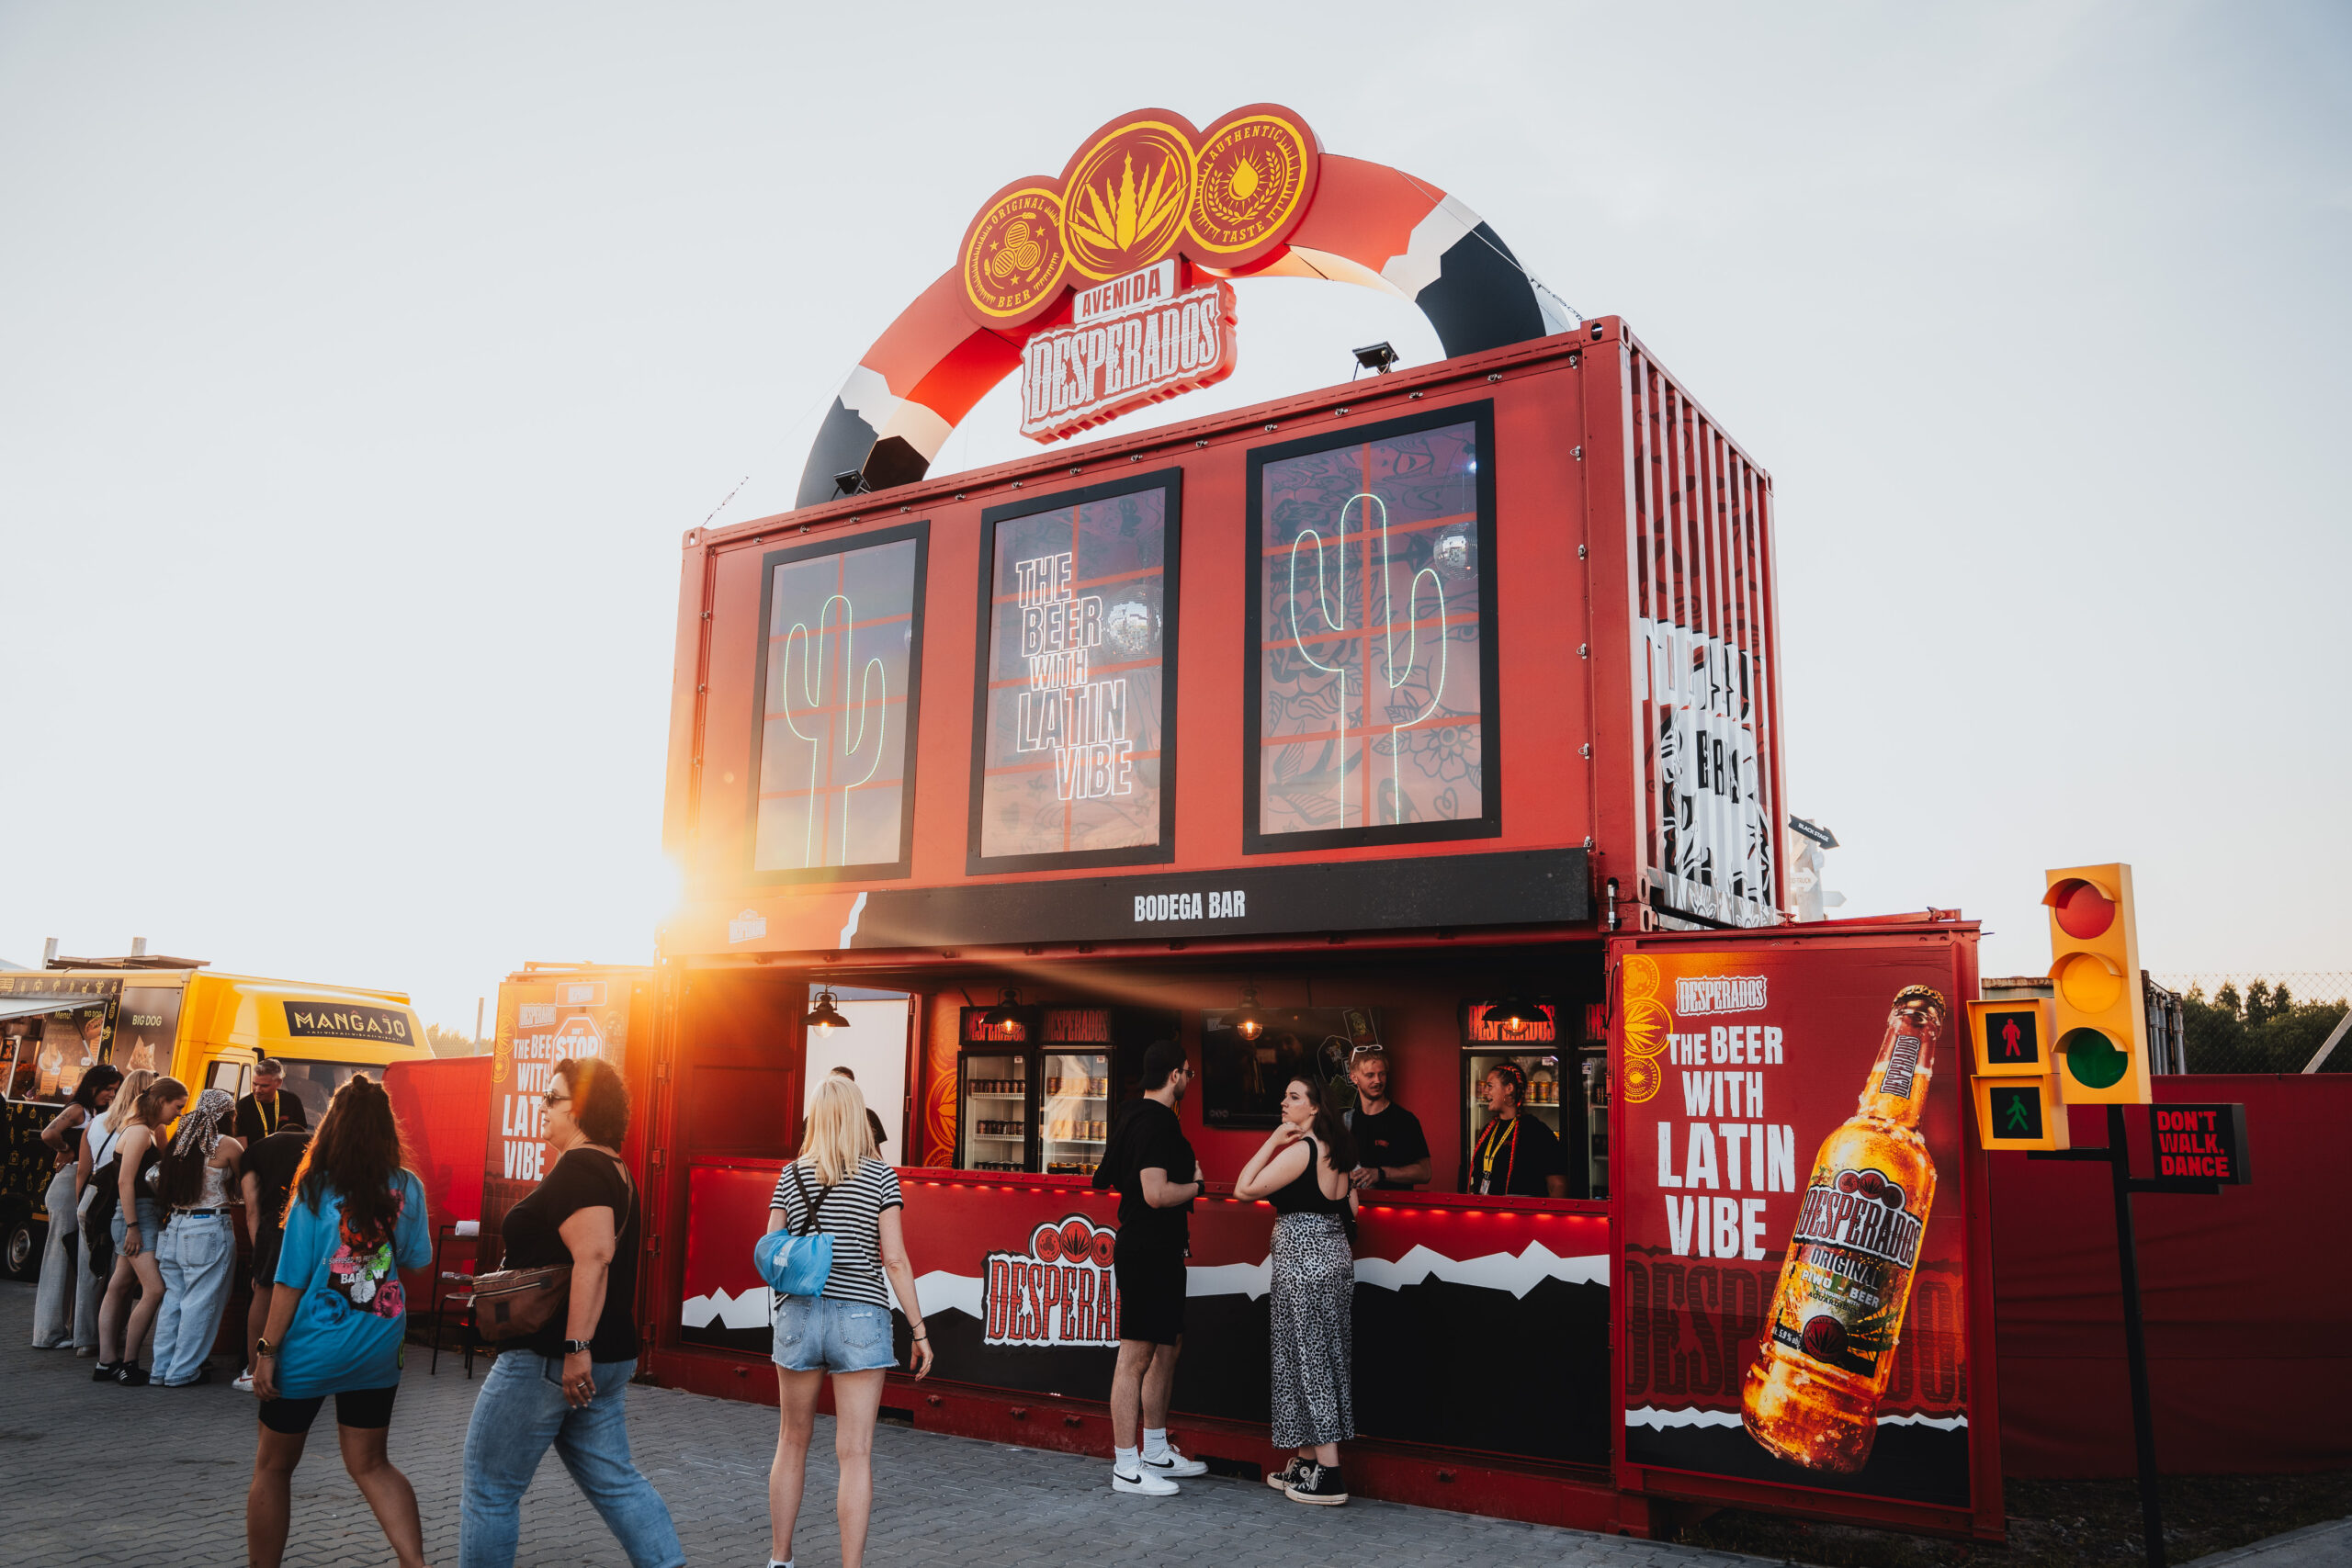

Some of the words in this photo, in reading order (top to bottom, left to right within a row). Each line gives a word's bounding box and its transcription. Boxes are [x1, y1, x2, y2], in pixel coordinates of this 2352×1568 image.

[1209, 125, 1283, 161] AUTHENTIC
[992, 197, 1044, 225] ORIGINAL
[1222, 221, 1264, 243] TASTE
[997, 288, 1032, 308] BEER
[1082, 267, 1162, 318] AVENIDA
[1028, 297, 1218, 421] DESPERADOS
[1016, 552, 1072, 608] THE
[1022, 596, 1102, 658] BEER
[1029, 649, 1088, 691] WITH
[1017, 680, 1126, 752] LATIN
[1055, 740, 1132, 800] VIBE
[1798, 823, 1815, 834] BLACK
[1814, 830, 1829, 841] STAGE
[1135, 893, 1204, 922] BODEGA
[1209, 890, 1246, 919] BAR
[1679, 979, 1764, 1012] DESPERADOS
[132, 1014, 144, 1026] BIG
[145, 1016, 162, 1027] DOG
[1044, 1010, 1108, 1042] DESPERADOS
[513, 1039, 530, 1060] THE
[531, 1034, 552, 1059] BEE
[555, 1036, 599, 1062] STOP
[1667, 1034, 1707, 1066] THE
[1711, 1026, 1783, 1065] BEER
[1883, 1036, 1919, 1096] DESPERADOS
[1681, 1071, 1764, 1117] WITH
[502, 1095, 545, 1139] LAT
[2157, 1111, 2216, 1132] DON'T
[503, 1140, 546, 1182] VIBE
[1657, 1122, 1795, 1192] LATIN
[2161, 1156, 2230, 1178] DANCE
[1665, 1195, 1766, 1260] VIBE
[1797, 1190, 1921, 1266] DESPERADOS
[1801, 1269, 1832, 1289] PIWO
[1849, 1286, 1880, 1308] BEER
[1810, 1247, 1879, 1291] ORIGINAL
[987, 1259, 1121, 1341] DESPERA
